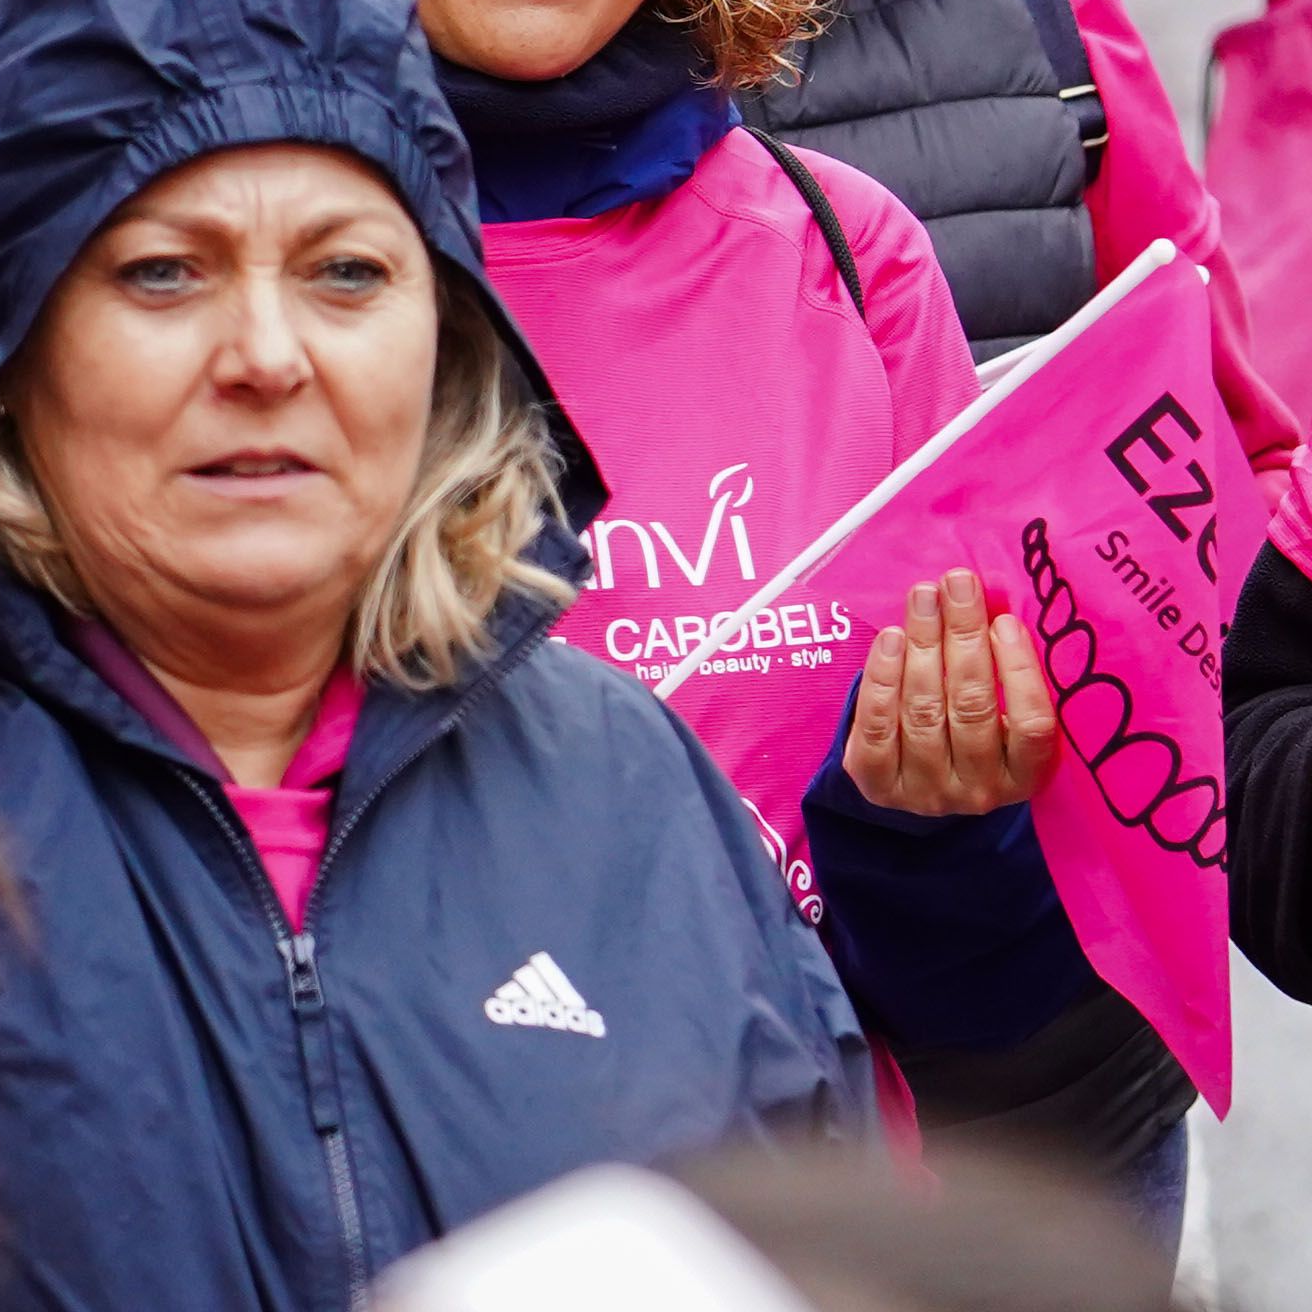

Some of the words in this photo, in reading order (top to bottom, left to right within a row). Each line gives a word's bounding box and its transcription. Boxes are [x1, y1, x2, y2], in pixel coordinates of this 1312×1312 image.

[1094, 530, 1182, 632] Smile
[699, 653, 771, 676] beauty
[791, 646, 833, 670] style
